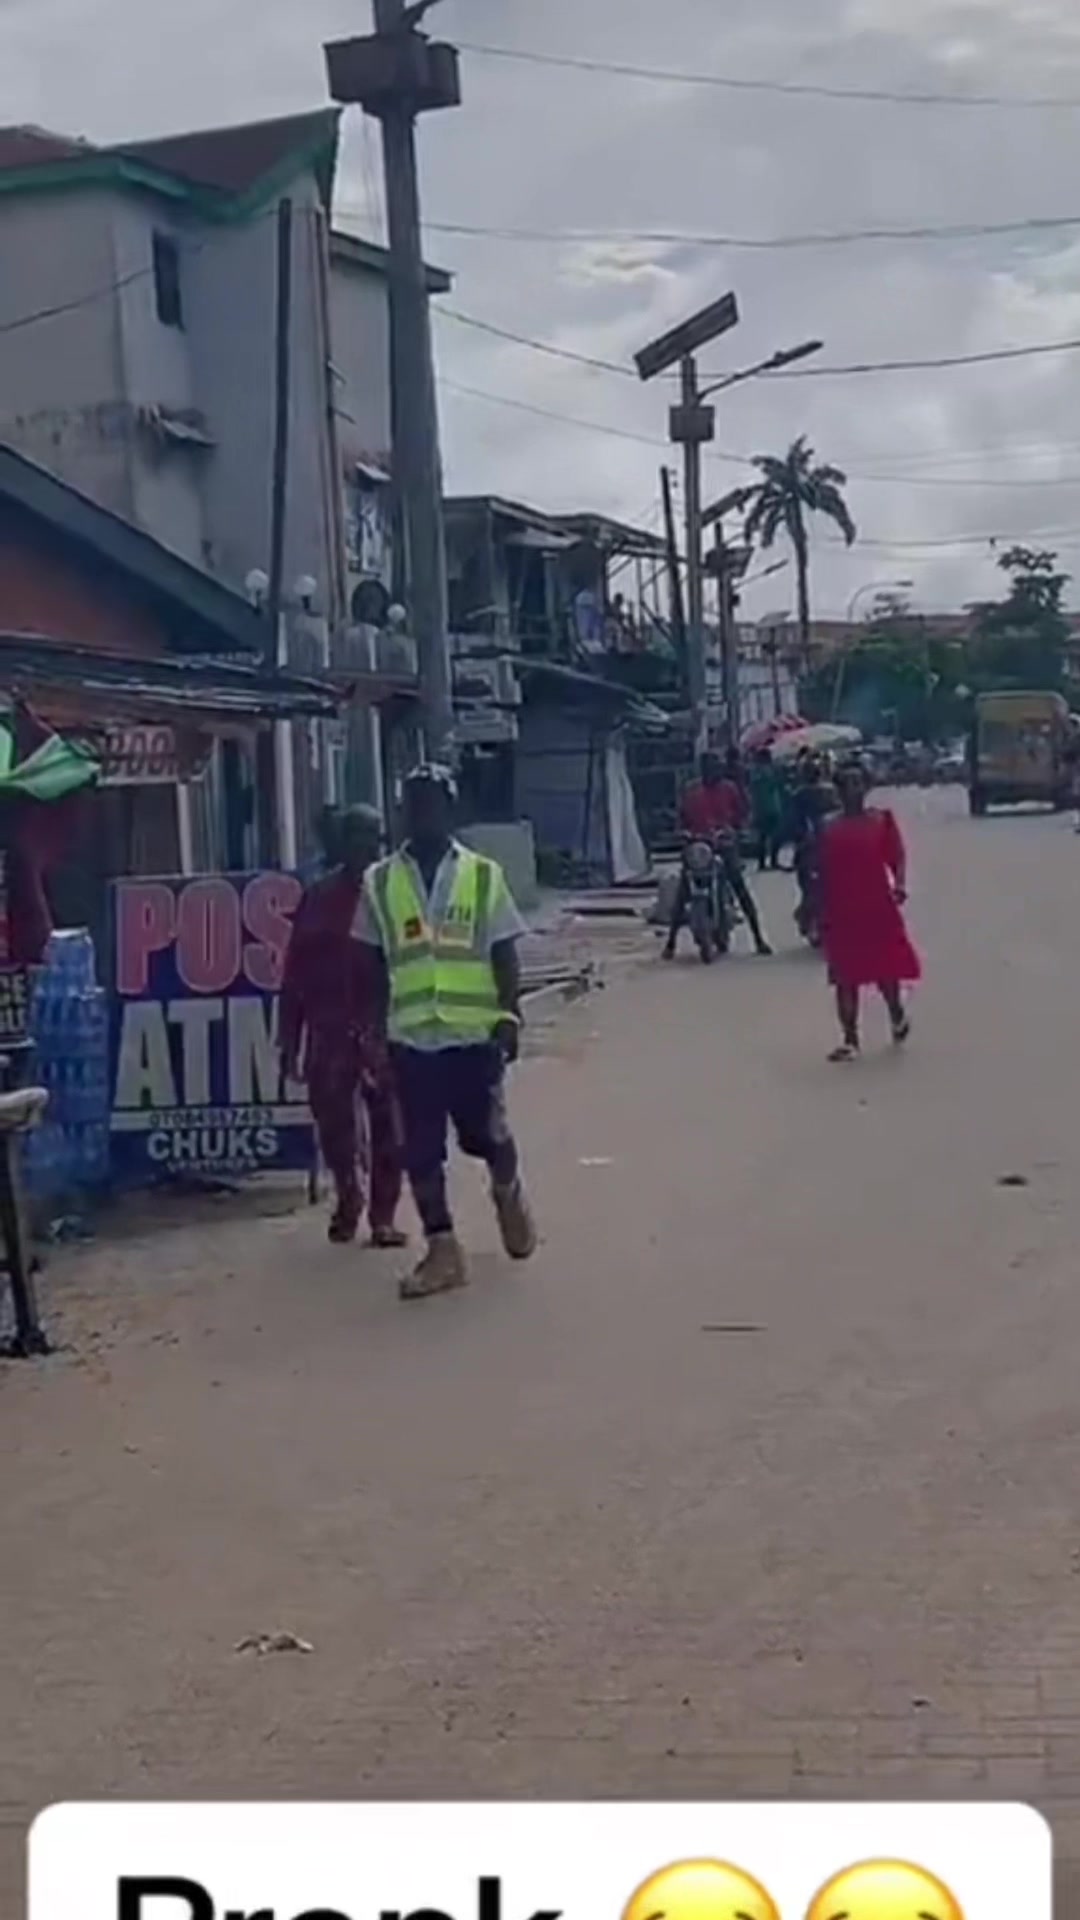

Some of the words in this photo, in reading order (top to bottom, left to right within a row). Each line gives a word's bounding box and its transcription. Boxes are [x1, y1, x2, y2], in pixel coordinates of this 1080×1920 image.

[116, 869, 304, 994] POS
[114, 995, 309, 1107] ATM
[147, 1128, 279, 1160] CHUKS
